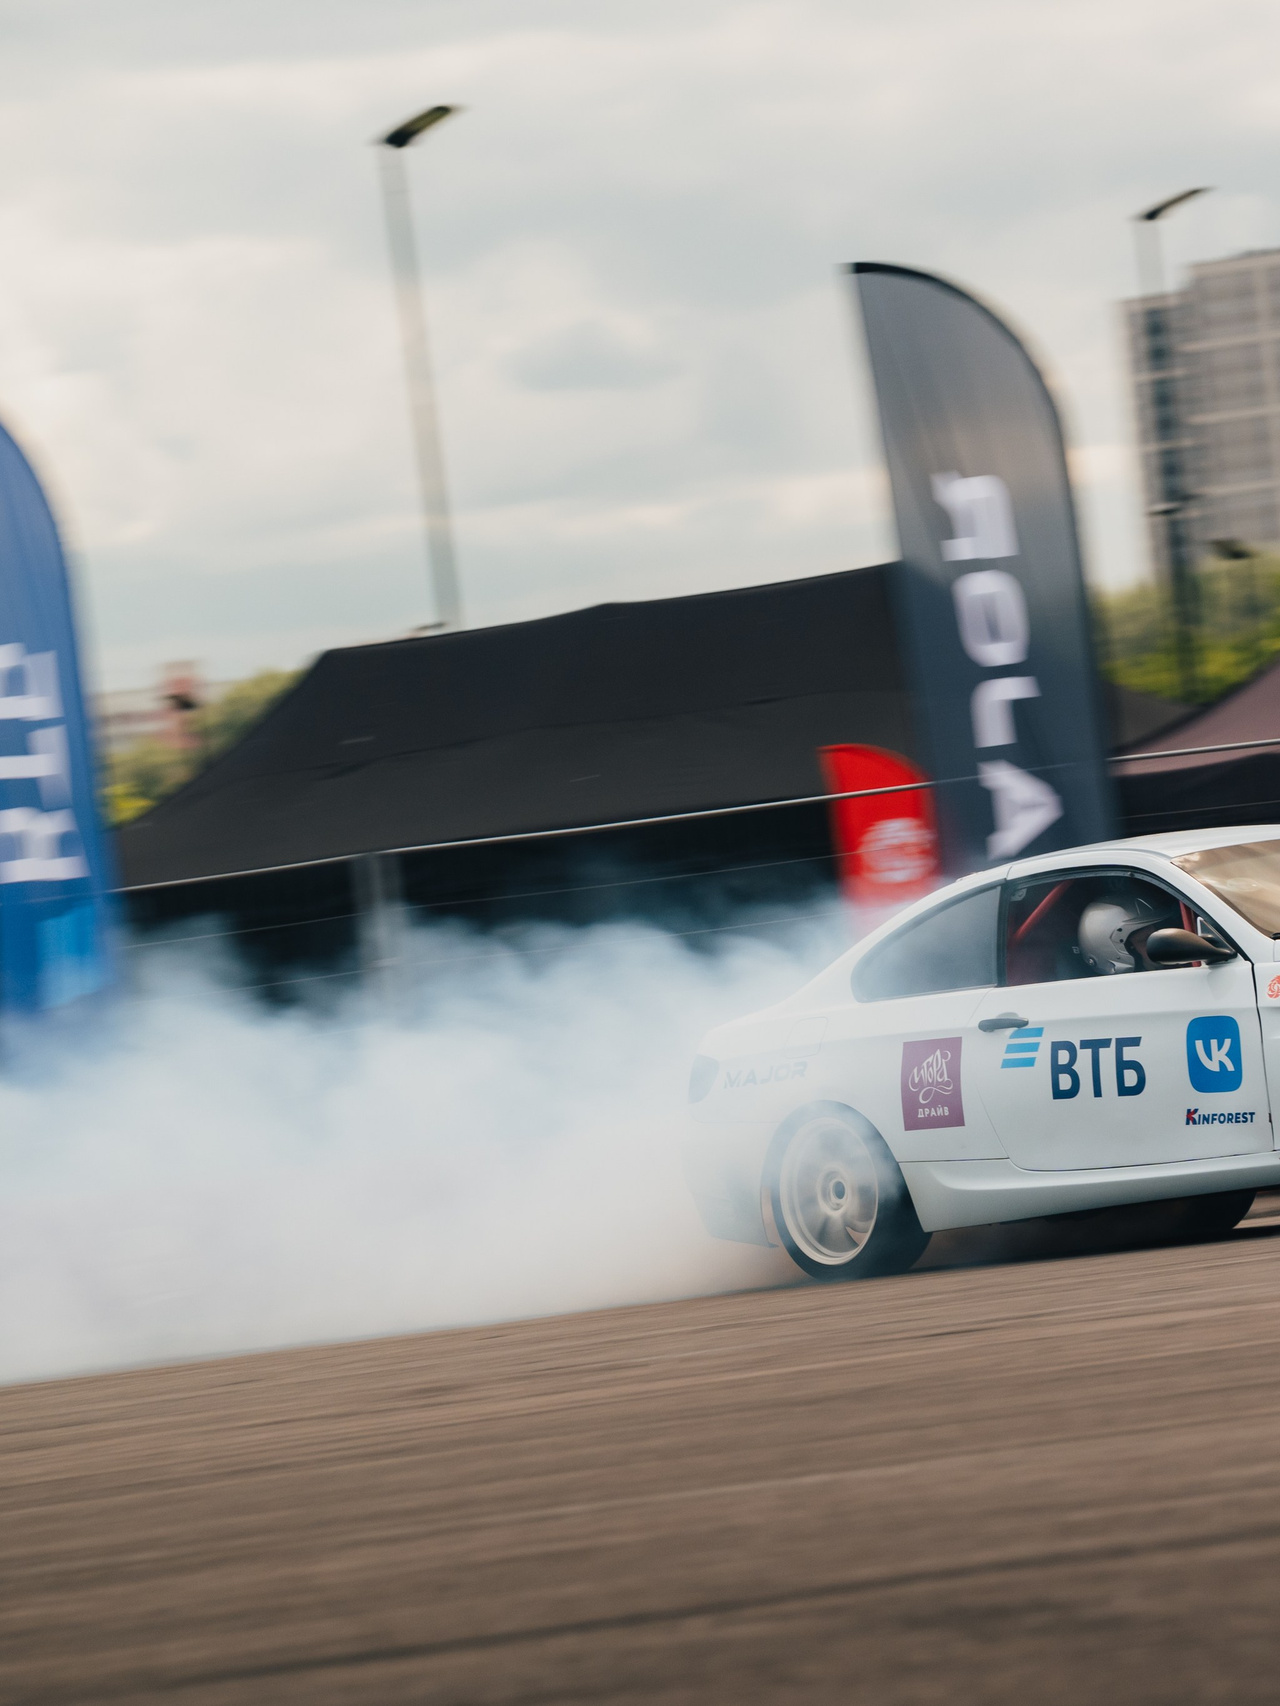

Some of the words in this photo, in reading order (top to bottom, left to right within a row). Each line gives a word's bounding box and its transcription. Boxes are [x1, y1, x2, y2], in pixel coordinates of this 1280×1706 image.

[1050, 1036, 1147, 1100] ВТБ
[1194, 1038, 1236, 1072] VK
[723, 1060, 809, 1089] MAJOR
[917, 1105, 950, 1118] ДРАЙВ
